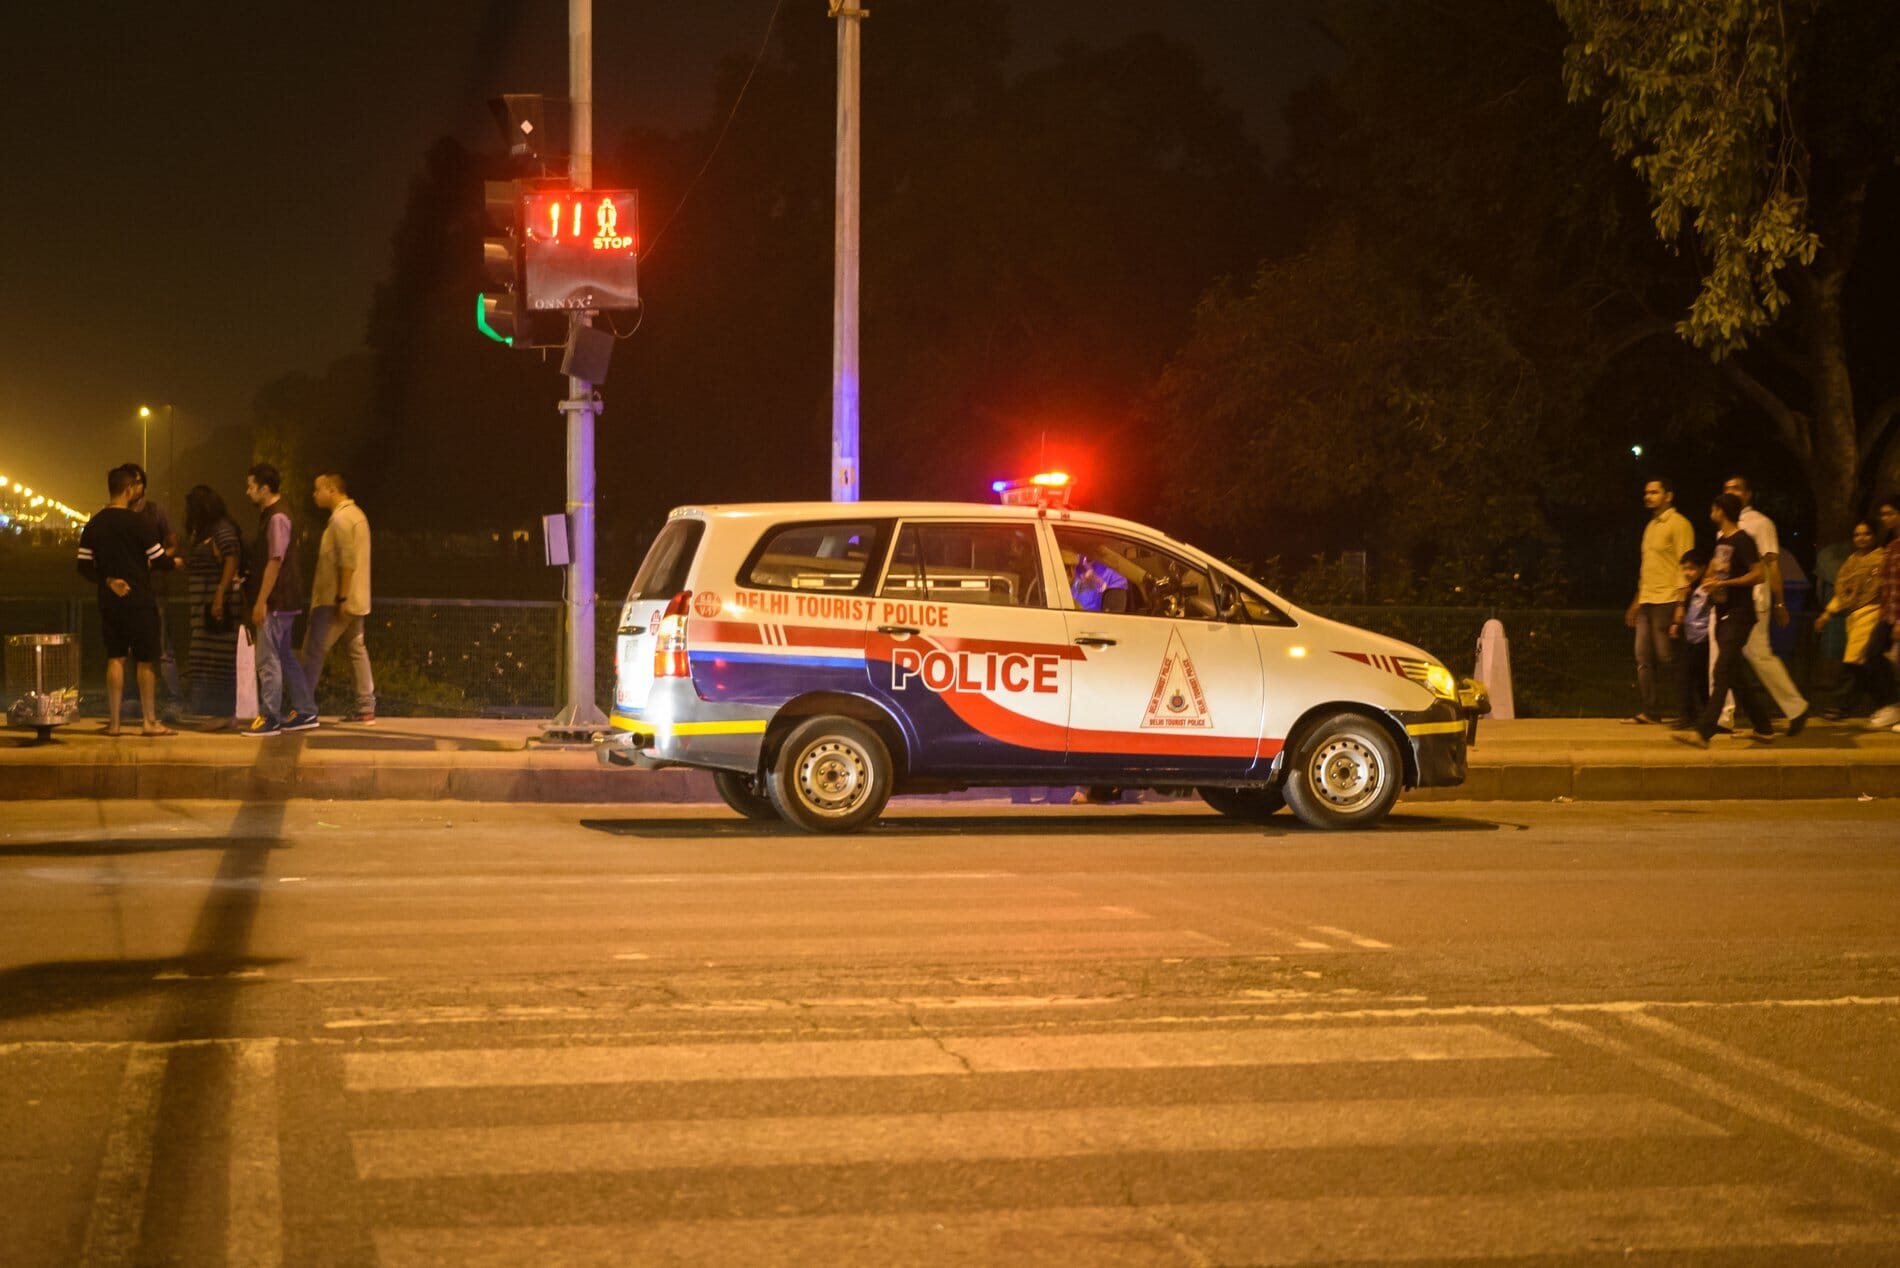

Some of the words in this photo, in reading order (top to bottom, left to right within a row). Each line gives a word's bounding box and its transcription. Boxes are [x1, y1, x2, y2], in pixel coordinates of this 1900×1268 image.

[593, 237, 633, 249] STOP
[535, 298, 586, 309] ONNYX
[735, 591, 789, 615] DELHI
[796, 595, 876, 622] TOURIST
[883, 602, 949, 627] POLICE
[892, 648, 1061, 694] POLICE
